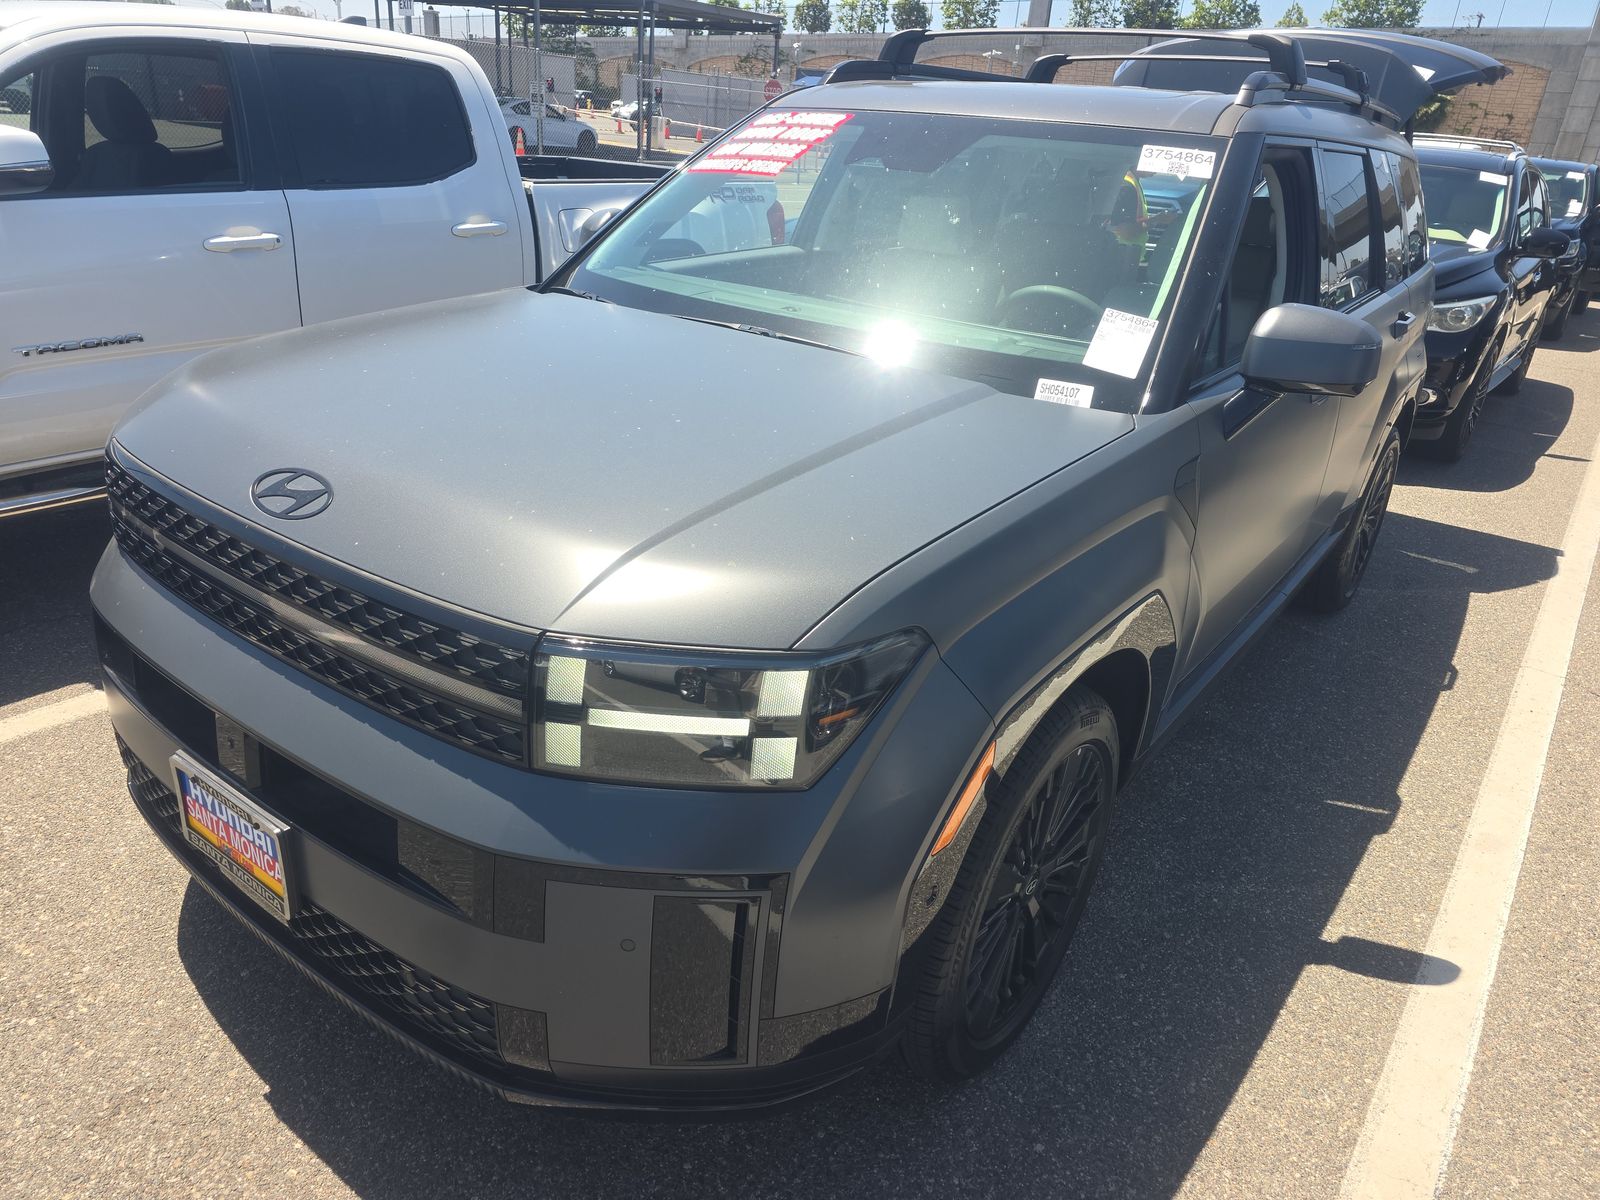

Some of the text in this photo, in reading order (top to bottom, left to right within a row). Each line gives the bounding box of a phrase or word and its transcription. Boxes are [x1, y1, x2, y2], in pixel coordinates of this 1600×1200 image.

[1143, 147, 1214, 165] 3754864
[1106, 309, 1157, 329] 3754864
[11, 331, 144, 357] TACOMA
[1039, 382, 1081, 399] SH054107
[1079, 711, 1100, 729] PIRELLI
[189, 779, 273, 857] HYUNDAI
[186, 795, 228, 842] SANTA
[230, 831, 282, 881] MONICA
[191, 834, 230, 868] SANTA
[232, 866, 283, 913] MONICA
